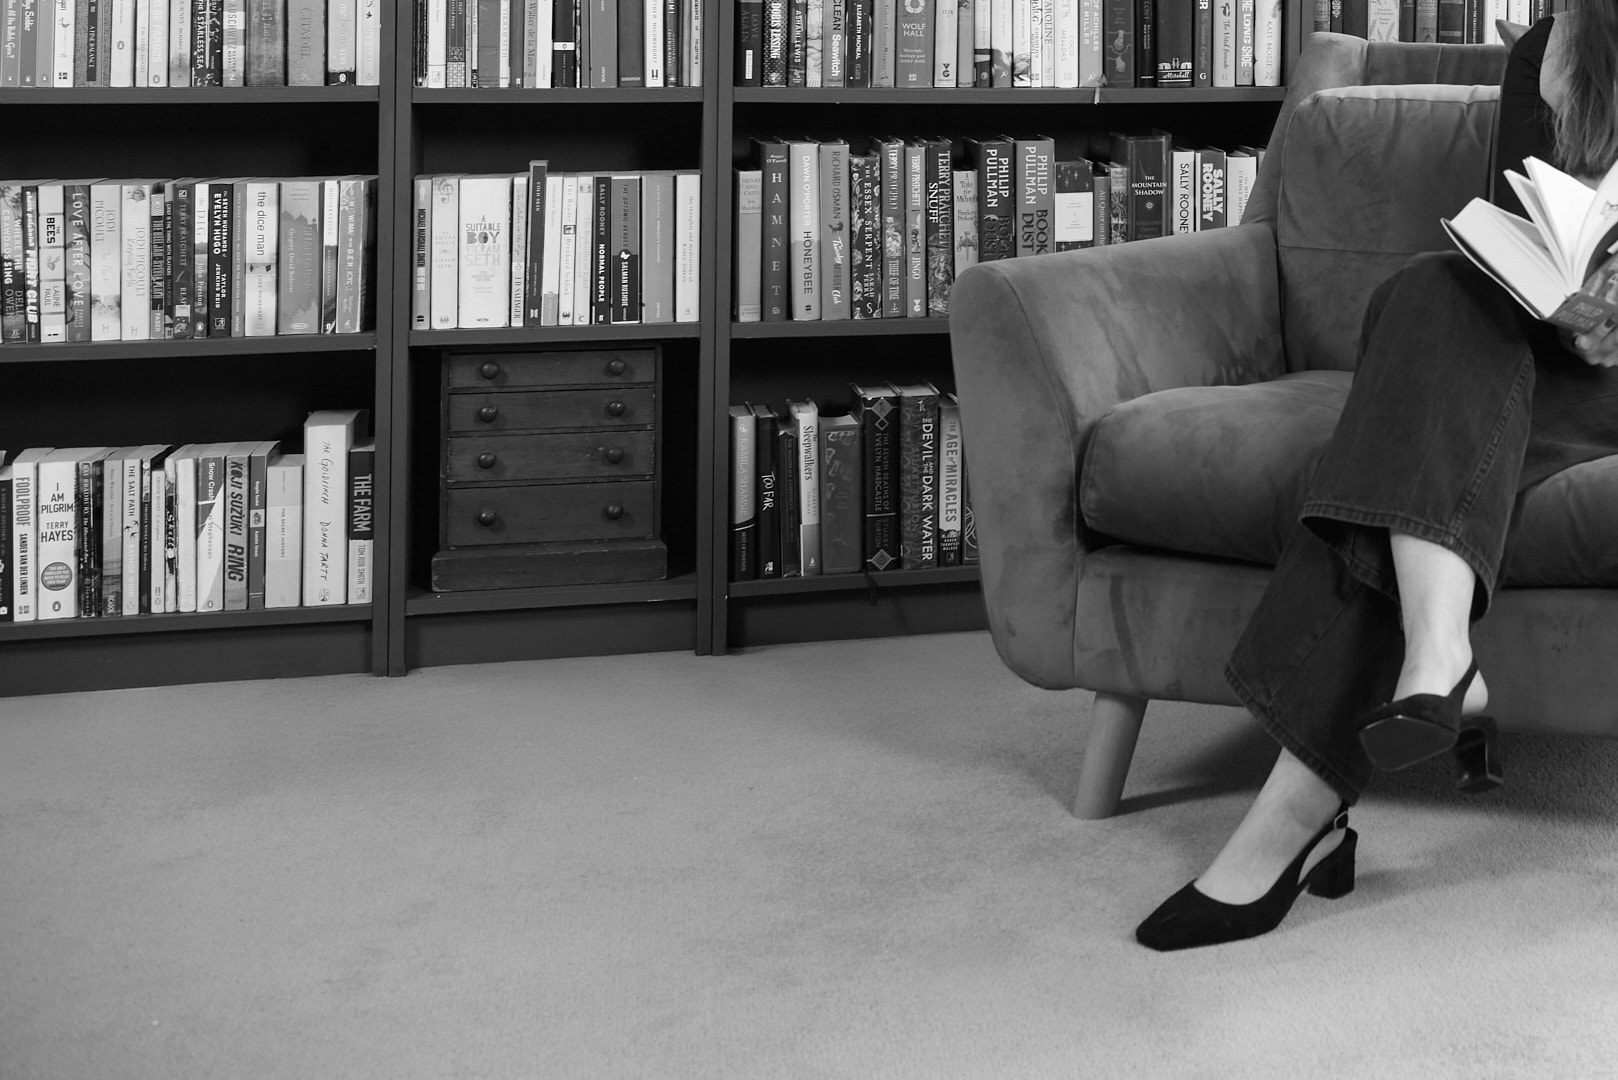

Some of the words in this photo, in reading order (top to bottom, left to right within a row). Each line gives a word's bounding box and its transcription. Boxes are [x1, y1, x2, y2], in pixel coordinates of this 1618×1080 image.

[832, 34, 841, 76] Seawitch
[1242, 46, 1251, 67] SHOE
[938, 151, 950, 187] TERRY
[1025, 146, 1036, 204] PULLMAN
[1037, 155, 1047, 195] PHILIP
[257, 192, 266, 207] the
[929, 183, 937, 223] SNUFF
[1202, 164, 1213, 221] ROONEY
[1213, 169, 1223, 213] SALLY
[73, 193, 83, 226] LOVE
[257, 211, 267, 230] dice
[938, 188, 950, 251] PRATCHETT
[46, 217, 55, 244] BEES
[213, 229, 221, 254] HUGO
[257, 235, 265, 256] man
[1022, 213, 1034, 251] DUST
[1036, 210, 1048, 254] BOOK
[73, 233, 83, 265] AFTER
[803, 231, 812, 294] HONEYBEE
[73, 273, 84, 305] LOVE
[946, 434, 957, 456] AGE
[230, 461, 243, 489] KOJI
[353, 474, 372, 496] THE
[16, 477, 30, 526] FOOLPROOF
[40, 504, 74, 514] PILGRIM
[922, 476, 933, 511] DARK
[946, 464, 958, 522] MIRACLES
[230, 492, 245, 536] SUZUKI
[353, 499, 371, 532] FARM
[41, 530, 73, 542] HAYES
[922, 515, 933, 560] WATER
[228, 544, 244, 581] RING
